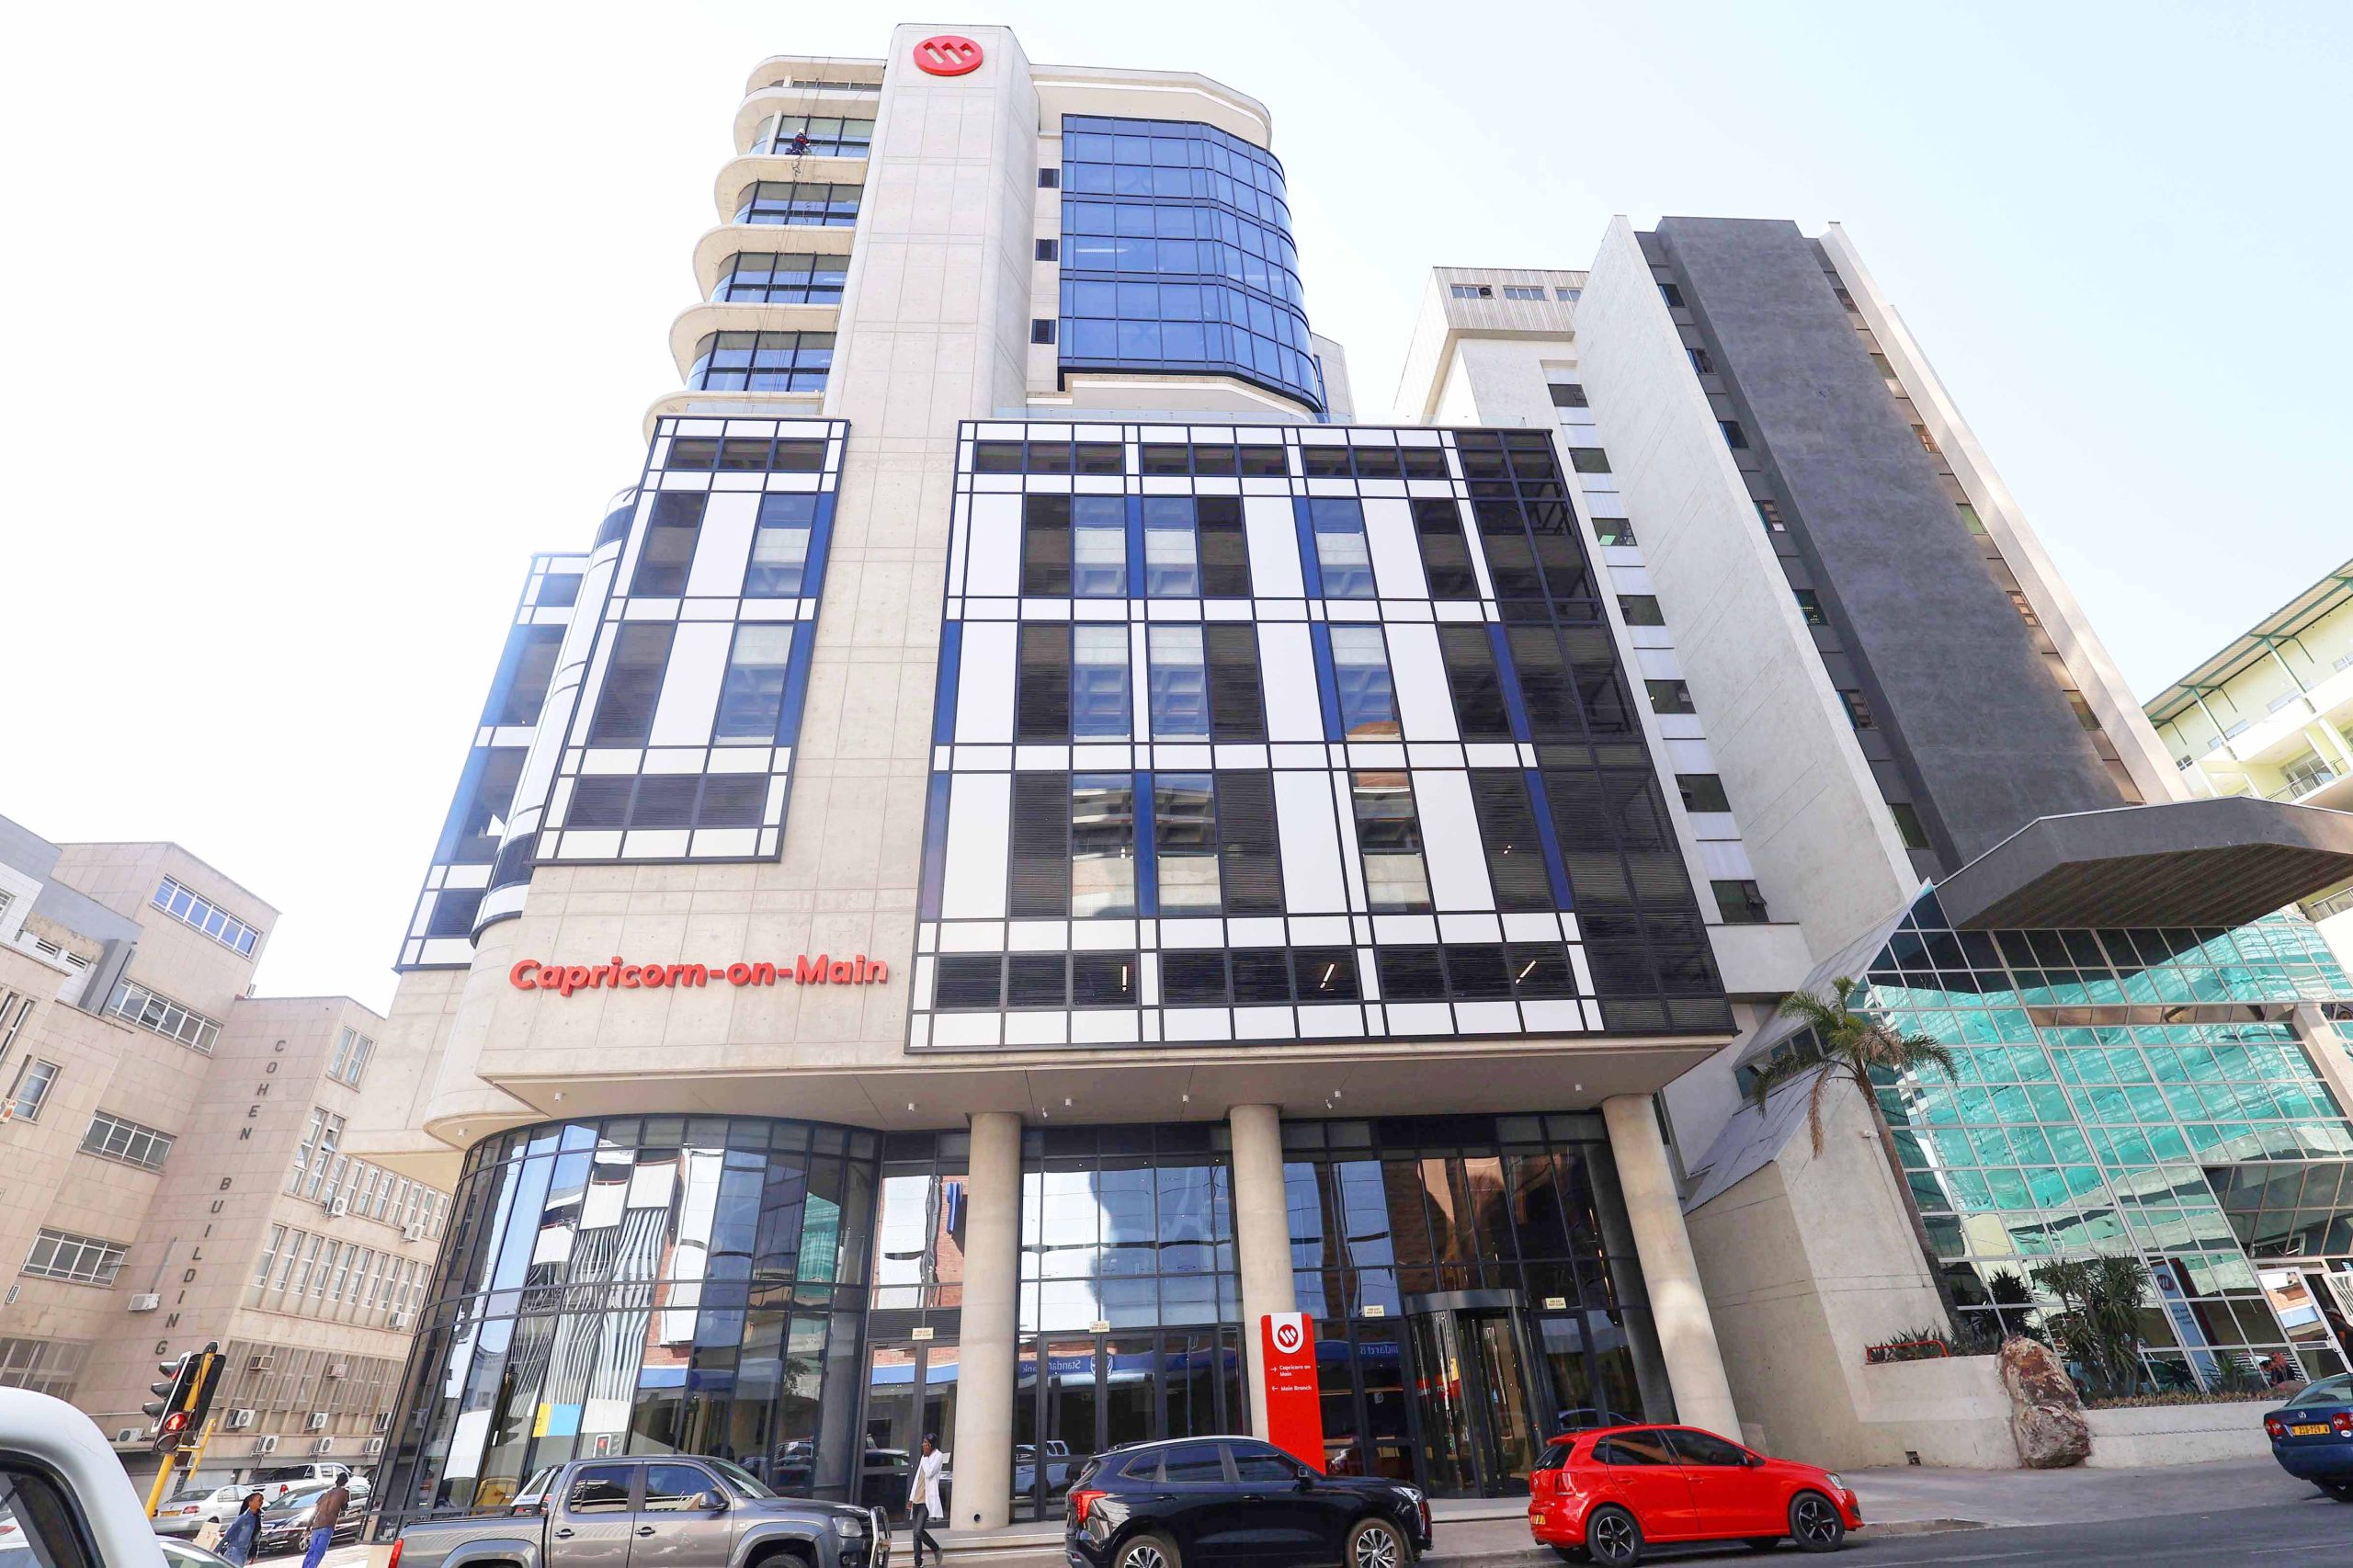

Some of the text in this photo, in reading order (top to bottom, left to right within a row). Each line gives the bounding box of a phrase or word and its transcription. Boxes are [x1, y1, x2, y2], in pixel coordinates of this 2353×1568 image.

[509, 954, 889, 997] Capricorn-on-Main
[154, 1040, 286, 1356] COHEN BUILDING
